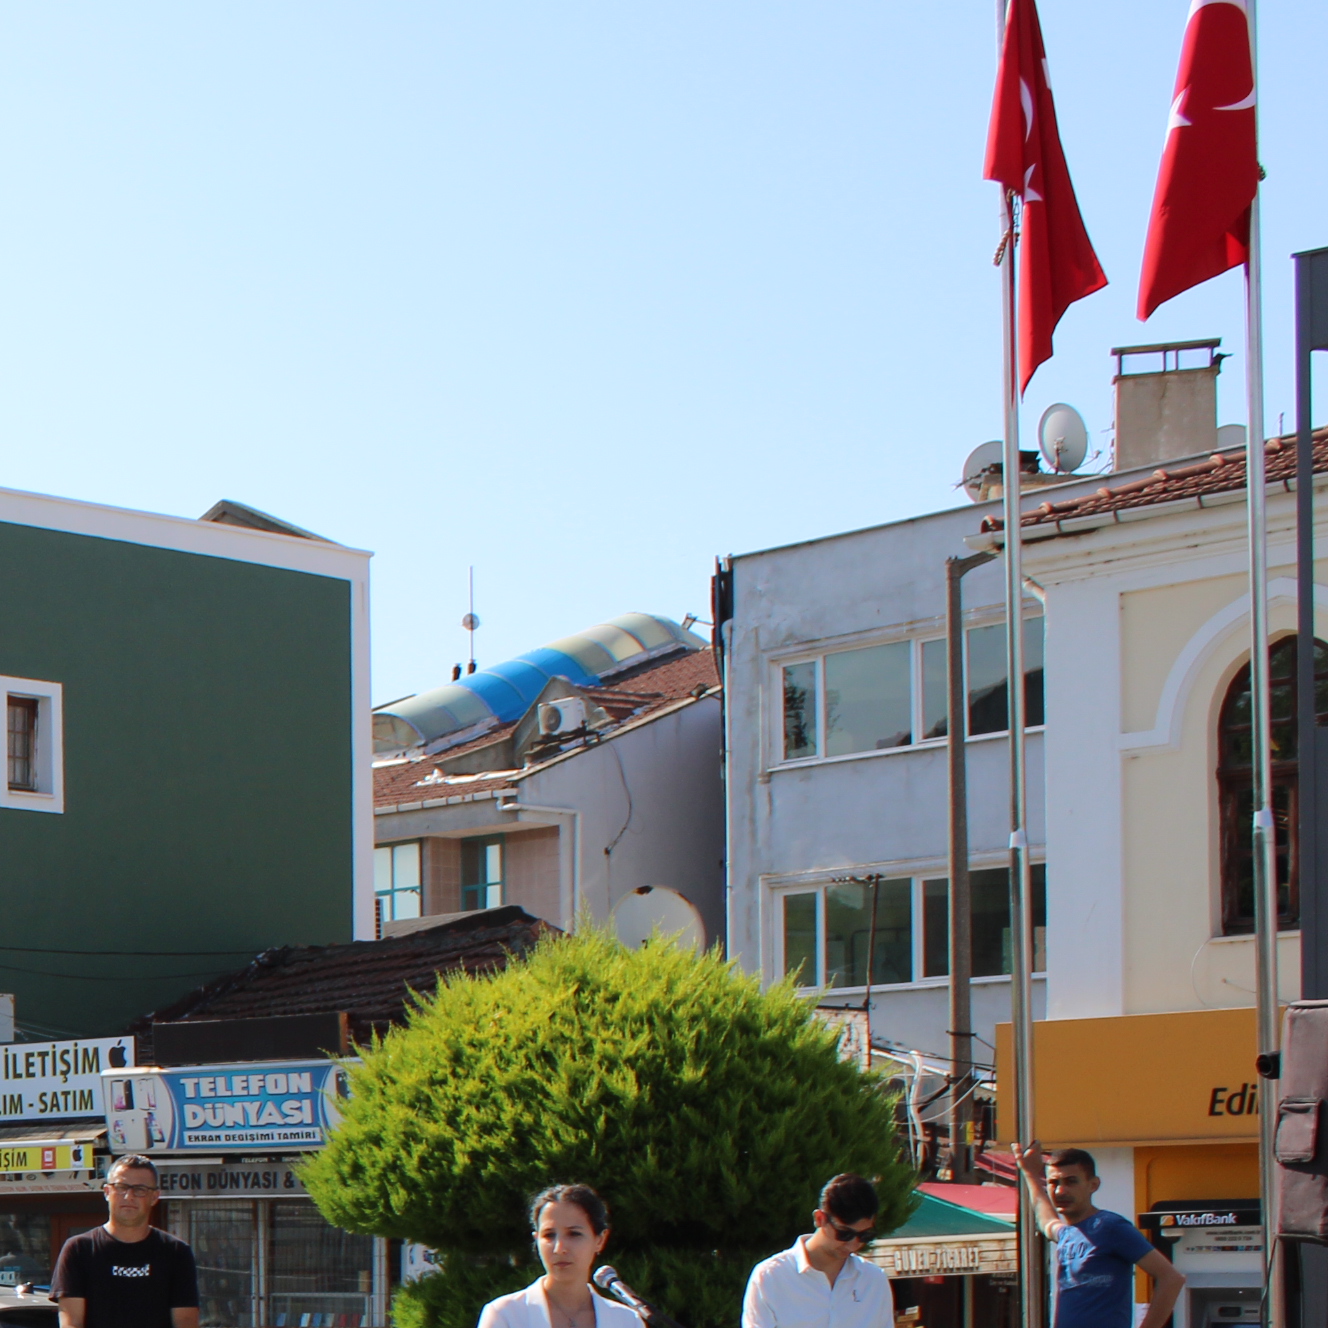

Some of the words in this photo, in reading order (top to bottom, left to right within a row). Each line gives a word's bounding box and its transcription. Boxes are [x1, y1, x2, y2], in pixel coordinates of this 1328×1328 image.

[3, 1042, 101, 1084] İLETİŞİM
[180, 1072, 312, 1099] TELEFON
[38, 1089, 95, 1113] SATIM
[1208, 1083, 1259, 1117] Edi
[183, 1099, 314, 1129] DÜNYASI
[188, 1132, 221, 1142] EKRAN
[277, 1130, 316, 1141] TAMİRİ
[207, 1169, 277, 1191] DÜNYASI
[284, 1172, 294, 1189] &
[894, 1246, 930, 1272] GÜVEN
[936, 1246, 979, 1269] TİCARET
